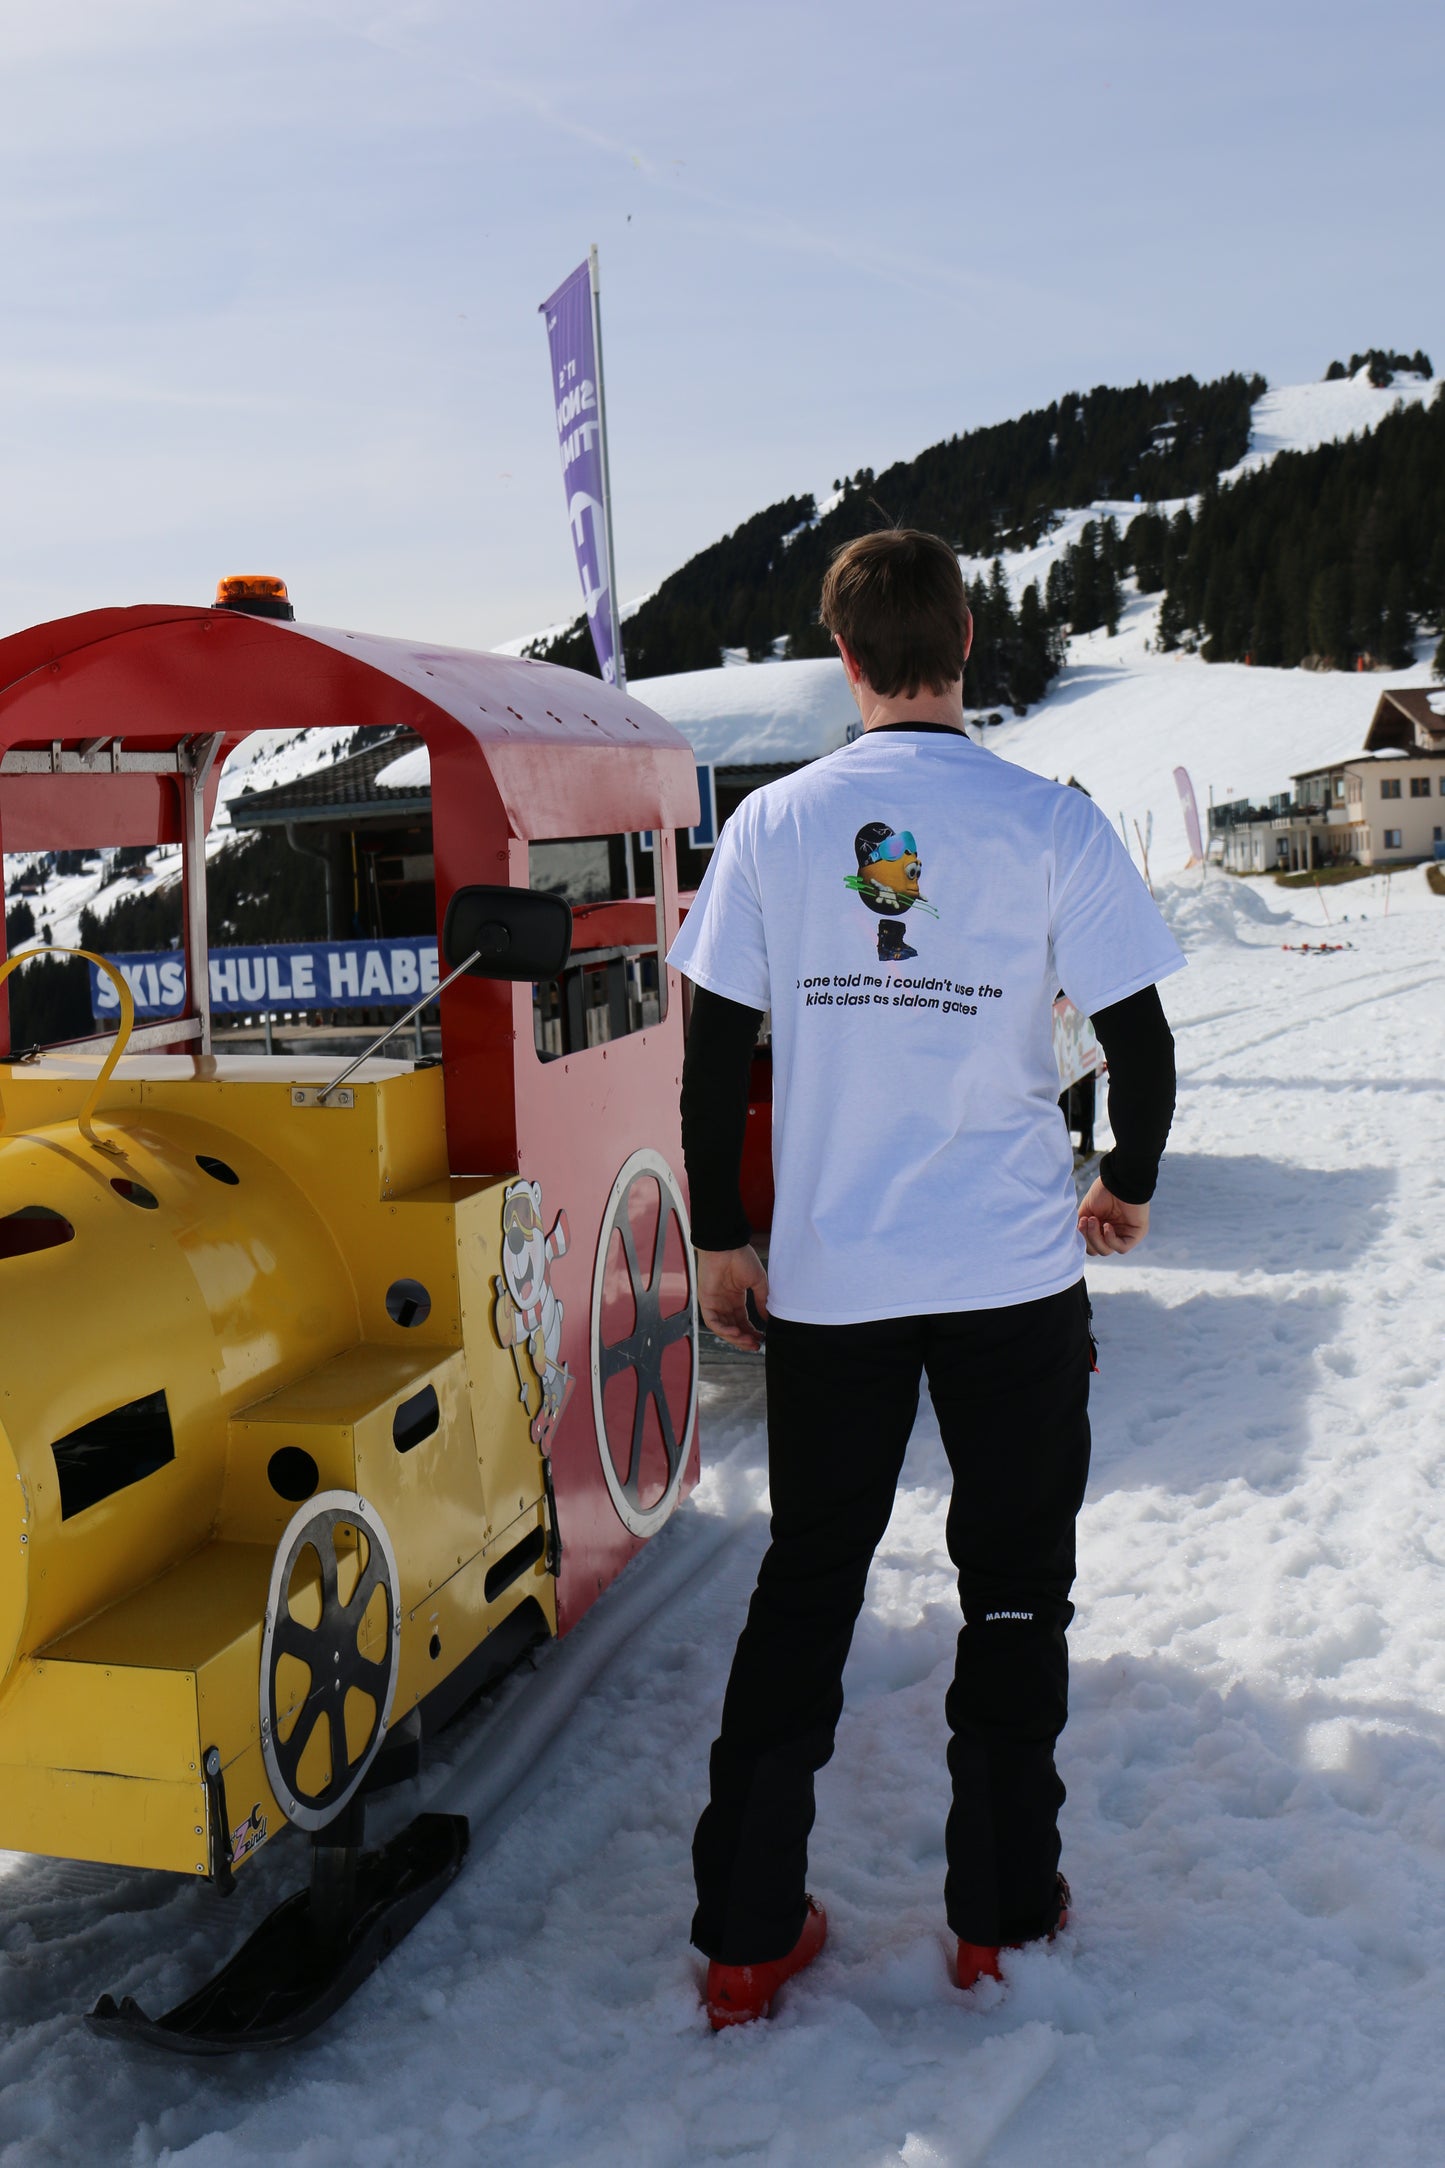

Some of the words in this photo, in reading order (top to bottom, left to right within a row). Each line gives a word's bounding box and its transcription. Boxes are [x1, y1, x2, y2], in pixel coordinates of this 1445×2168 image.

[97, 955, 316, 1009] SKISHULE
[328, 946, 440, 998] HABE
[803, 977, 830, 988] one
[833, 974, 861, 987] told
[863, 976, 882, 987] me
[885, 975, 891, 988] i
[893, 977, 952, 992] couldn't
[955, 983, 975, 996] use
[978, 984, 1003, 998] the
[806, 992, 834, 1006] kids
[836, 993, 871, 1006] class
[873, 994, 890, 1005] as
[892, 994, 939, 1008] slalom
[942, 1000, 978, 1015] gates
[986, 1611, 1033, 1621] MAMMUT
